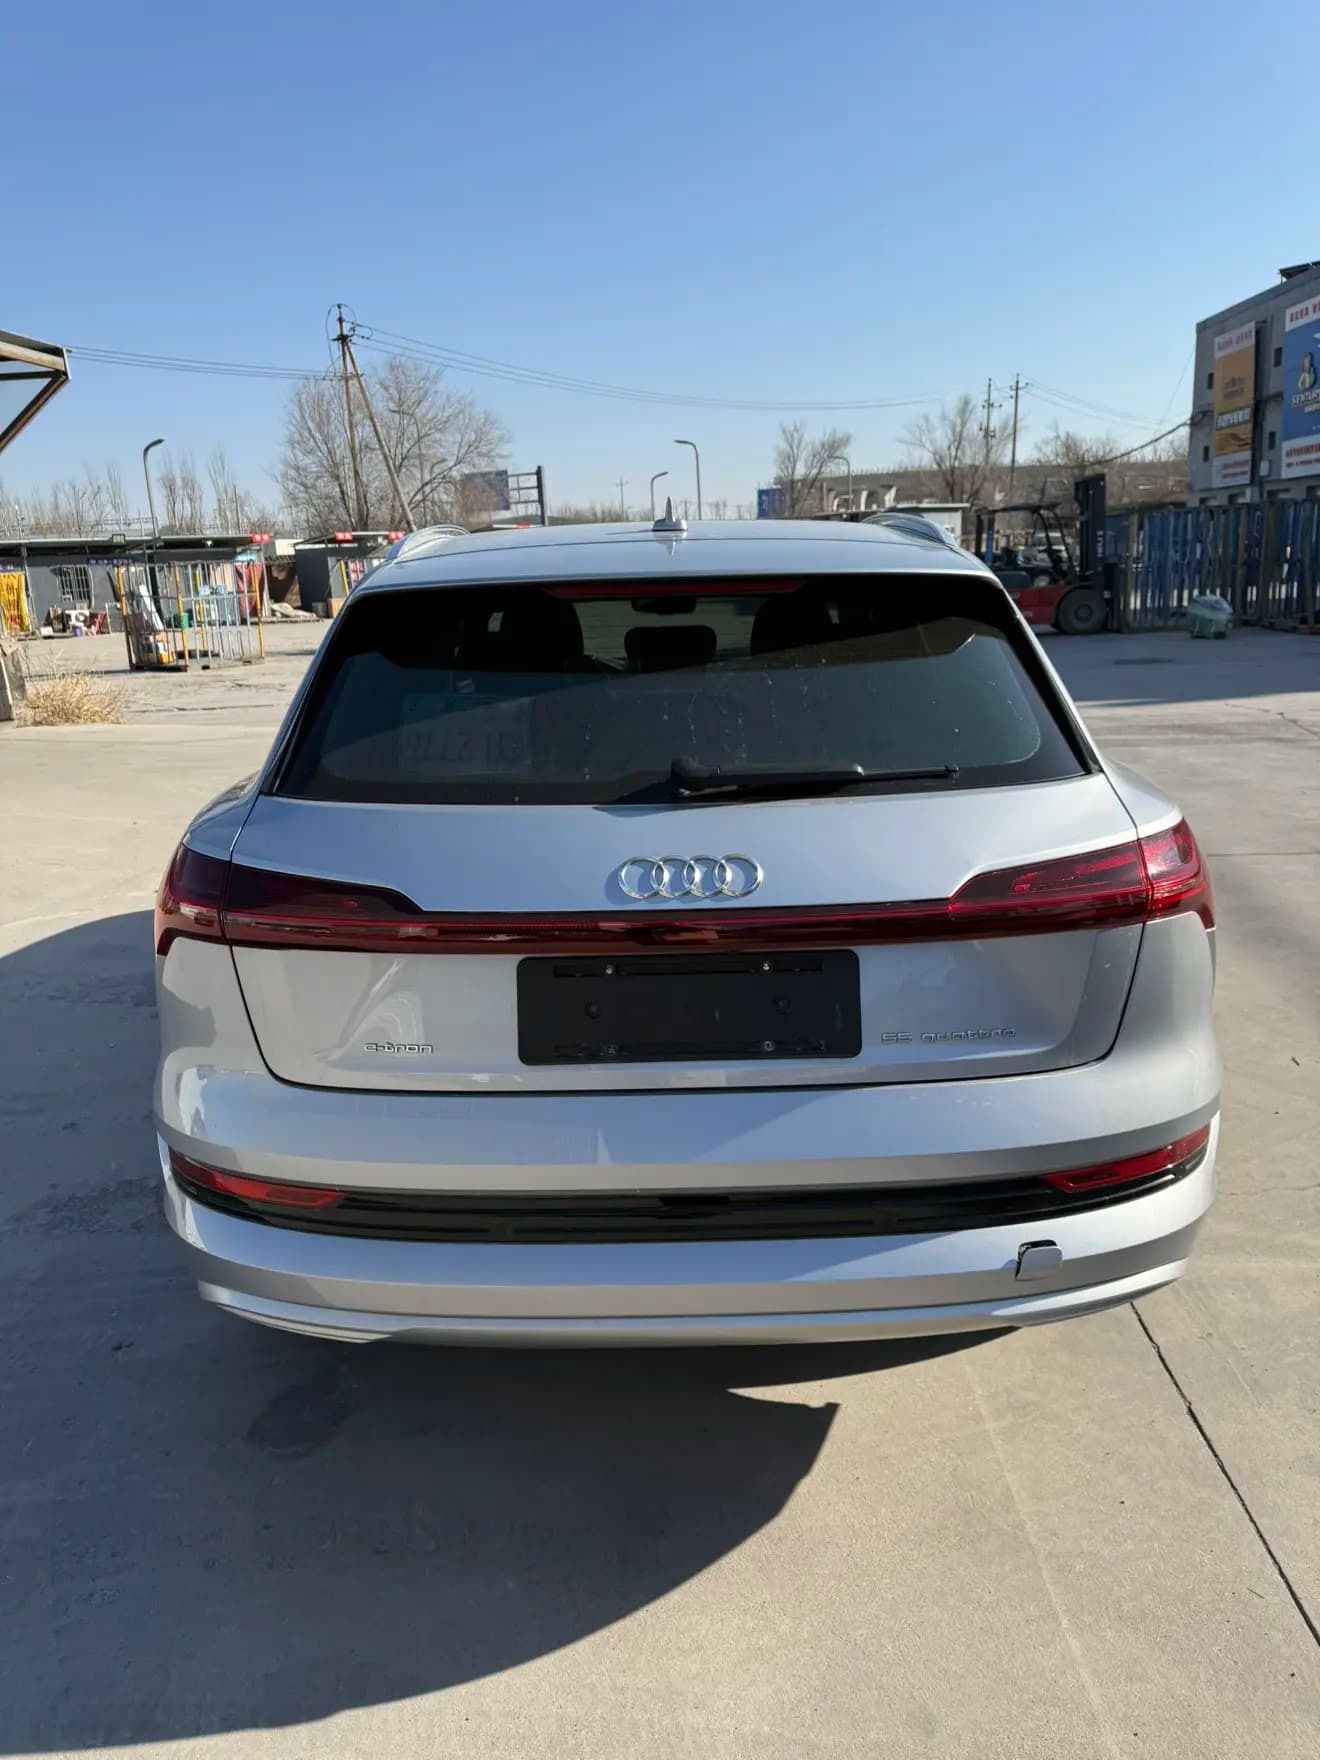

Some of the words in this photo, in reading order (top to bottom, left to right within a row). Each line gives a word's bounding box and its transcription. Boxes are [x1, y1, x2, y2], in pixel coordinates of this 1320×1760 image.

[881, 1032, 912, 1042] 55
[921, 1028, 1016, 1043] quattro
[364, 1042, 434, 1054] e-tron
